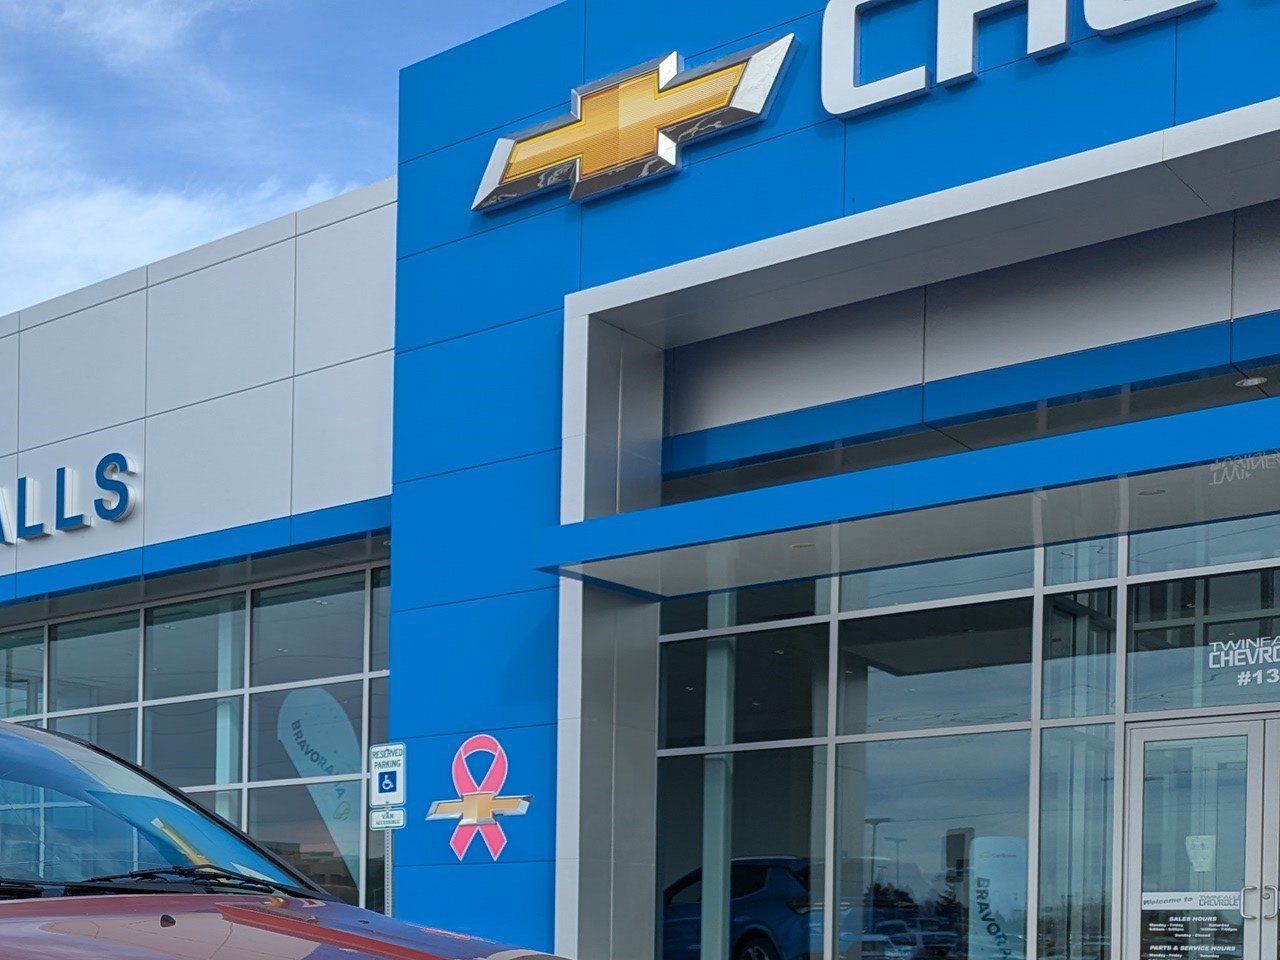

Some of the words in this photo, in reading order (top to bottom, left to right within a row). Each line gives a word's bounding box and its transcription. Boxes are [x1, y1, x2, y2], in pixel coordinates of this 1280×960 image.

[291, 719, 348, 799] BRAVORAA
[372, 748, 403, 760] RESERVED
[373, 759, 402, 770] PARKING
[1143, 898, 1182, 906] Welcome
